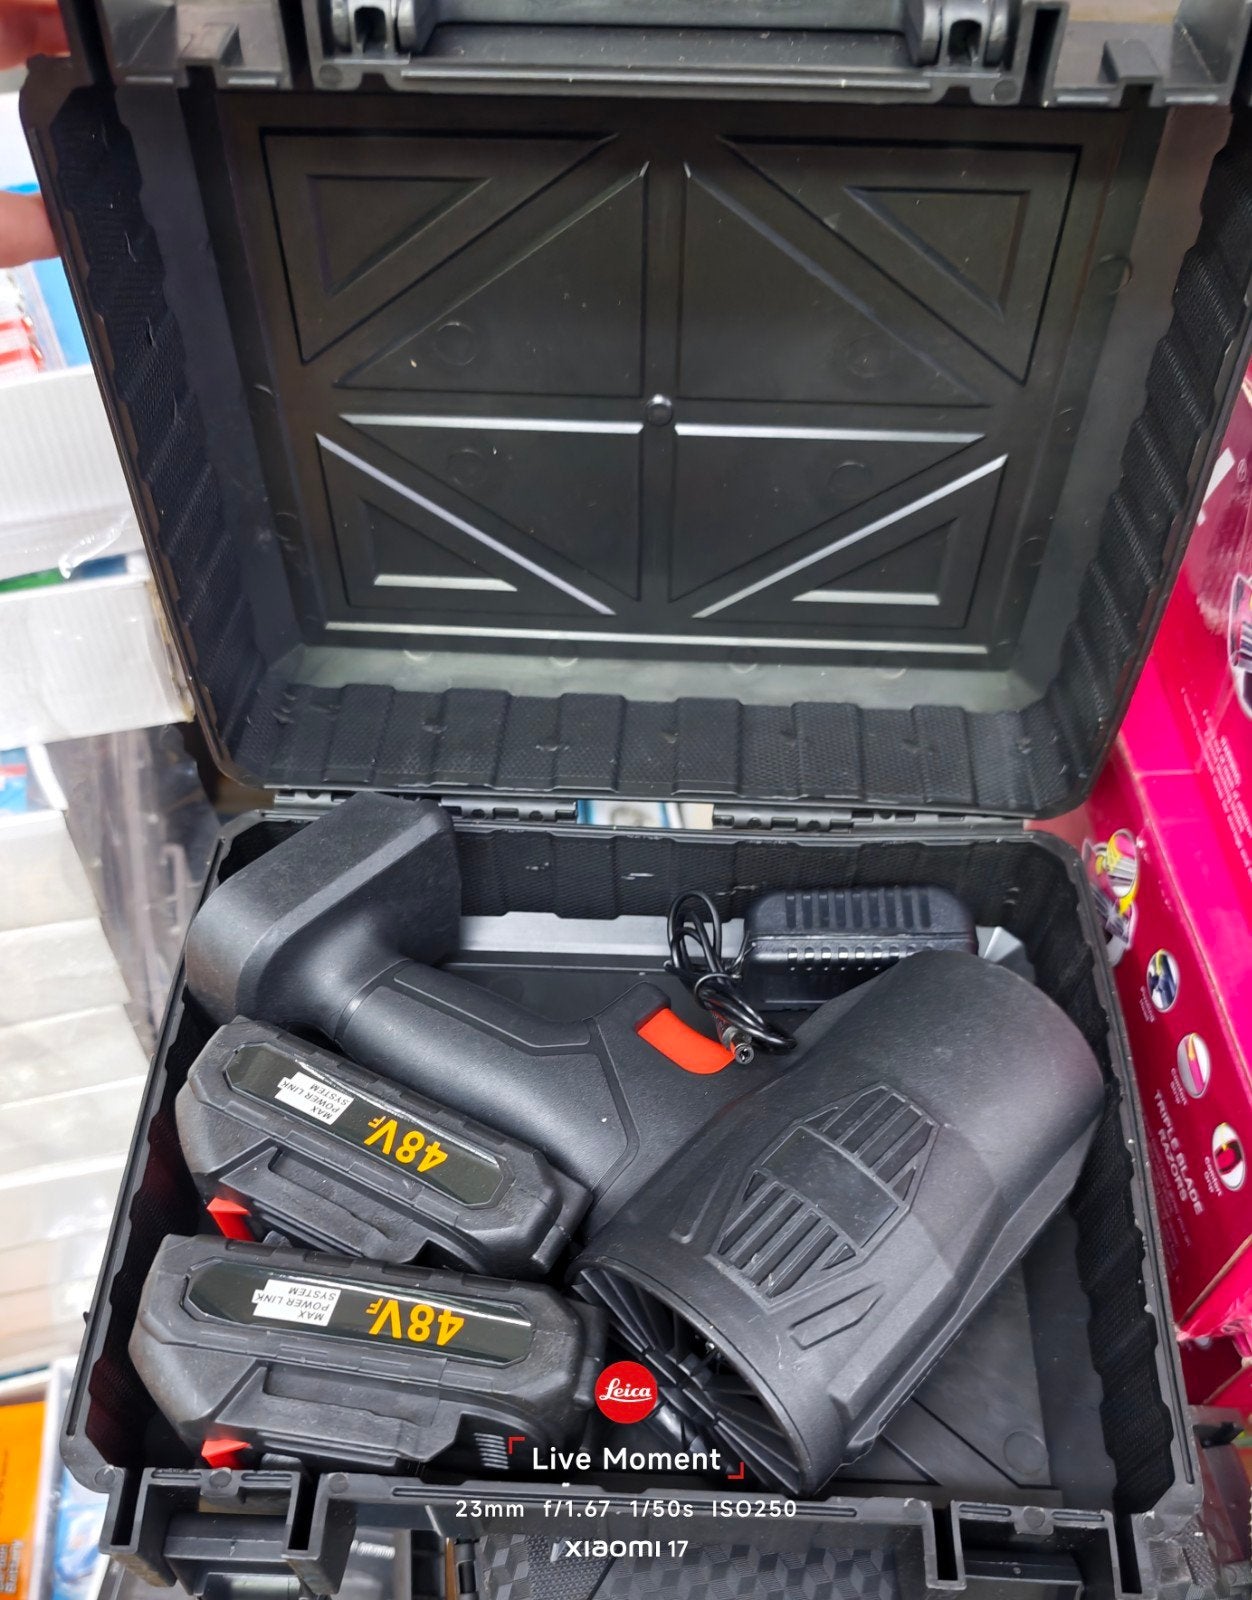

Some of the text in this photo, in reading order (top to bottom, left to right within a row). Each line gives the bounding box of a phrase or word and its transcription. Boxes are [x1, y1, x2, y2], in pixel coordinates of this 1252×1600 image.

[281, 1080, 341, 1113] POWER LINK
[310, 1083, 350, 1106] SYSTEM
[311, 1105, 333, 1120] MAX
[1154, 1089, 1180, 1152] TRIPLE
[1176, 1152, 1205, 1216] BLADE
[1157, 1128, 1188, 1202] RAZORS
[256, 1293, 330, 1312] POWER LINK
[288, 1286, 337, 1301] SYSTEM
[298, 1309, 325, 1321] MAX
